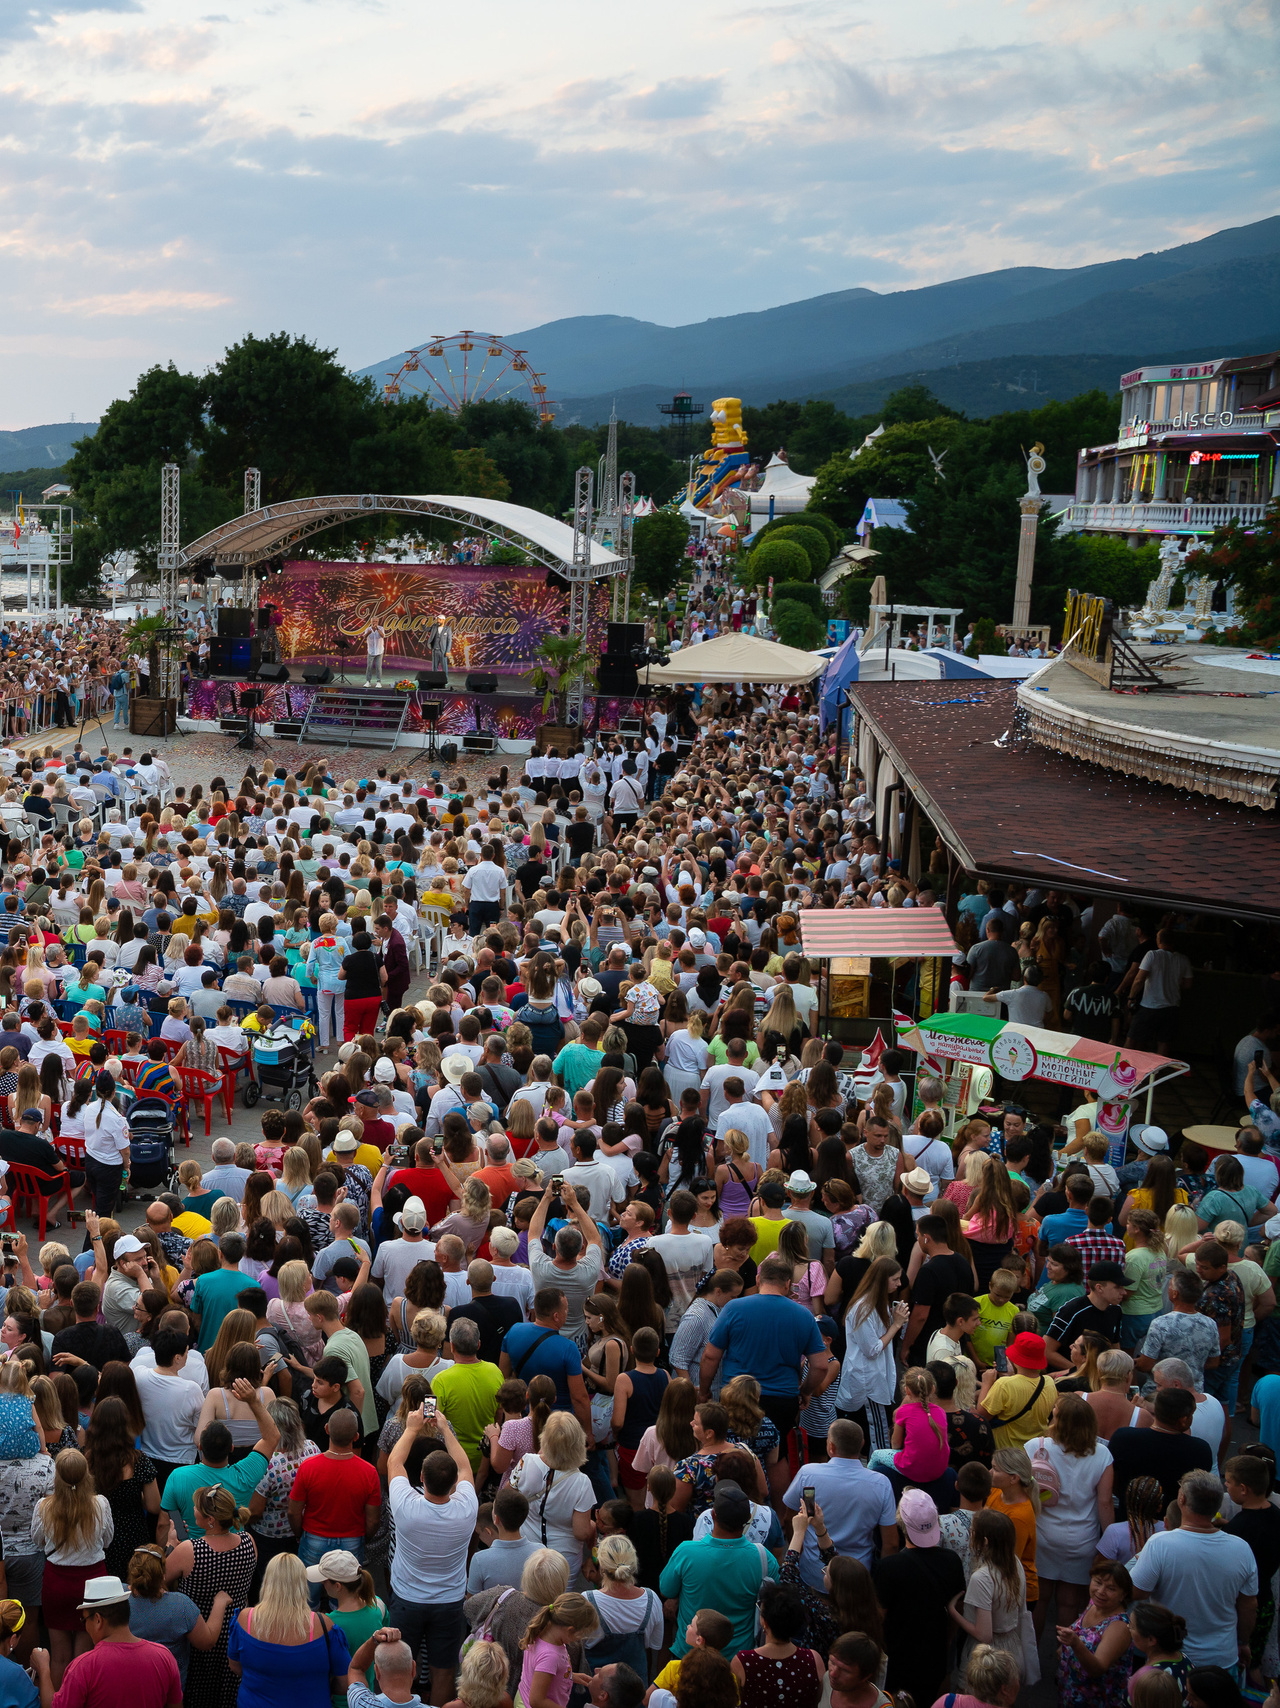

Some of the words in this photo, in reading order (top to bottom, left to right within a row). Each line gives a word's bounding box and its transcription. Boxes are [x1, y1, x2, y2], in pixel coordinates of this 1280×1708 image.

[1041, 1055, 1097, 1071] НАТУРАЛЬНЫЕ
[1041, 1062, 1097, 1079] МОЛОЧНЫЕ
[1040, 1070, 1091, 1087] КОКТЕЙЛИ
